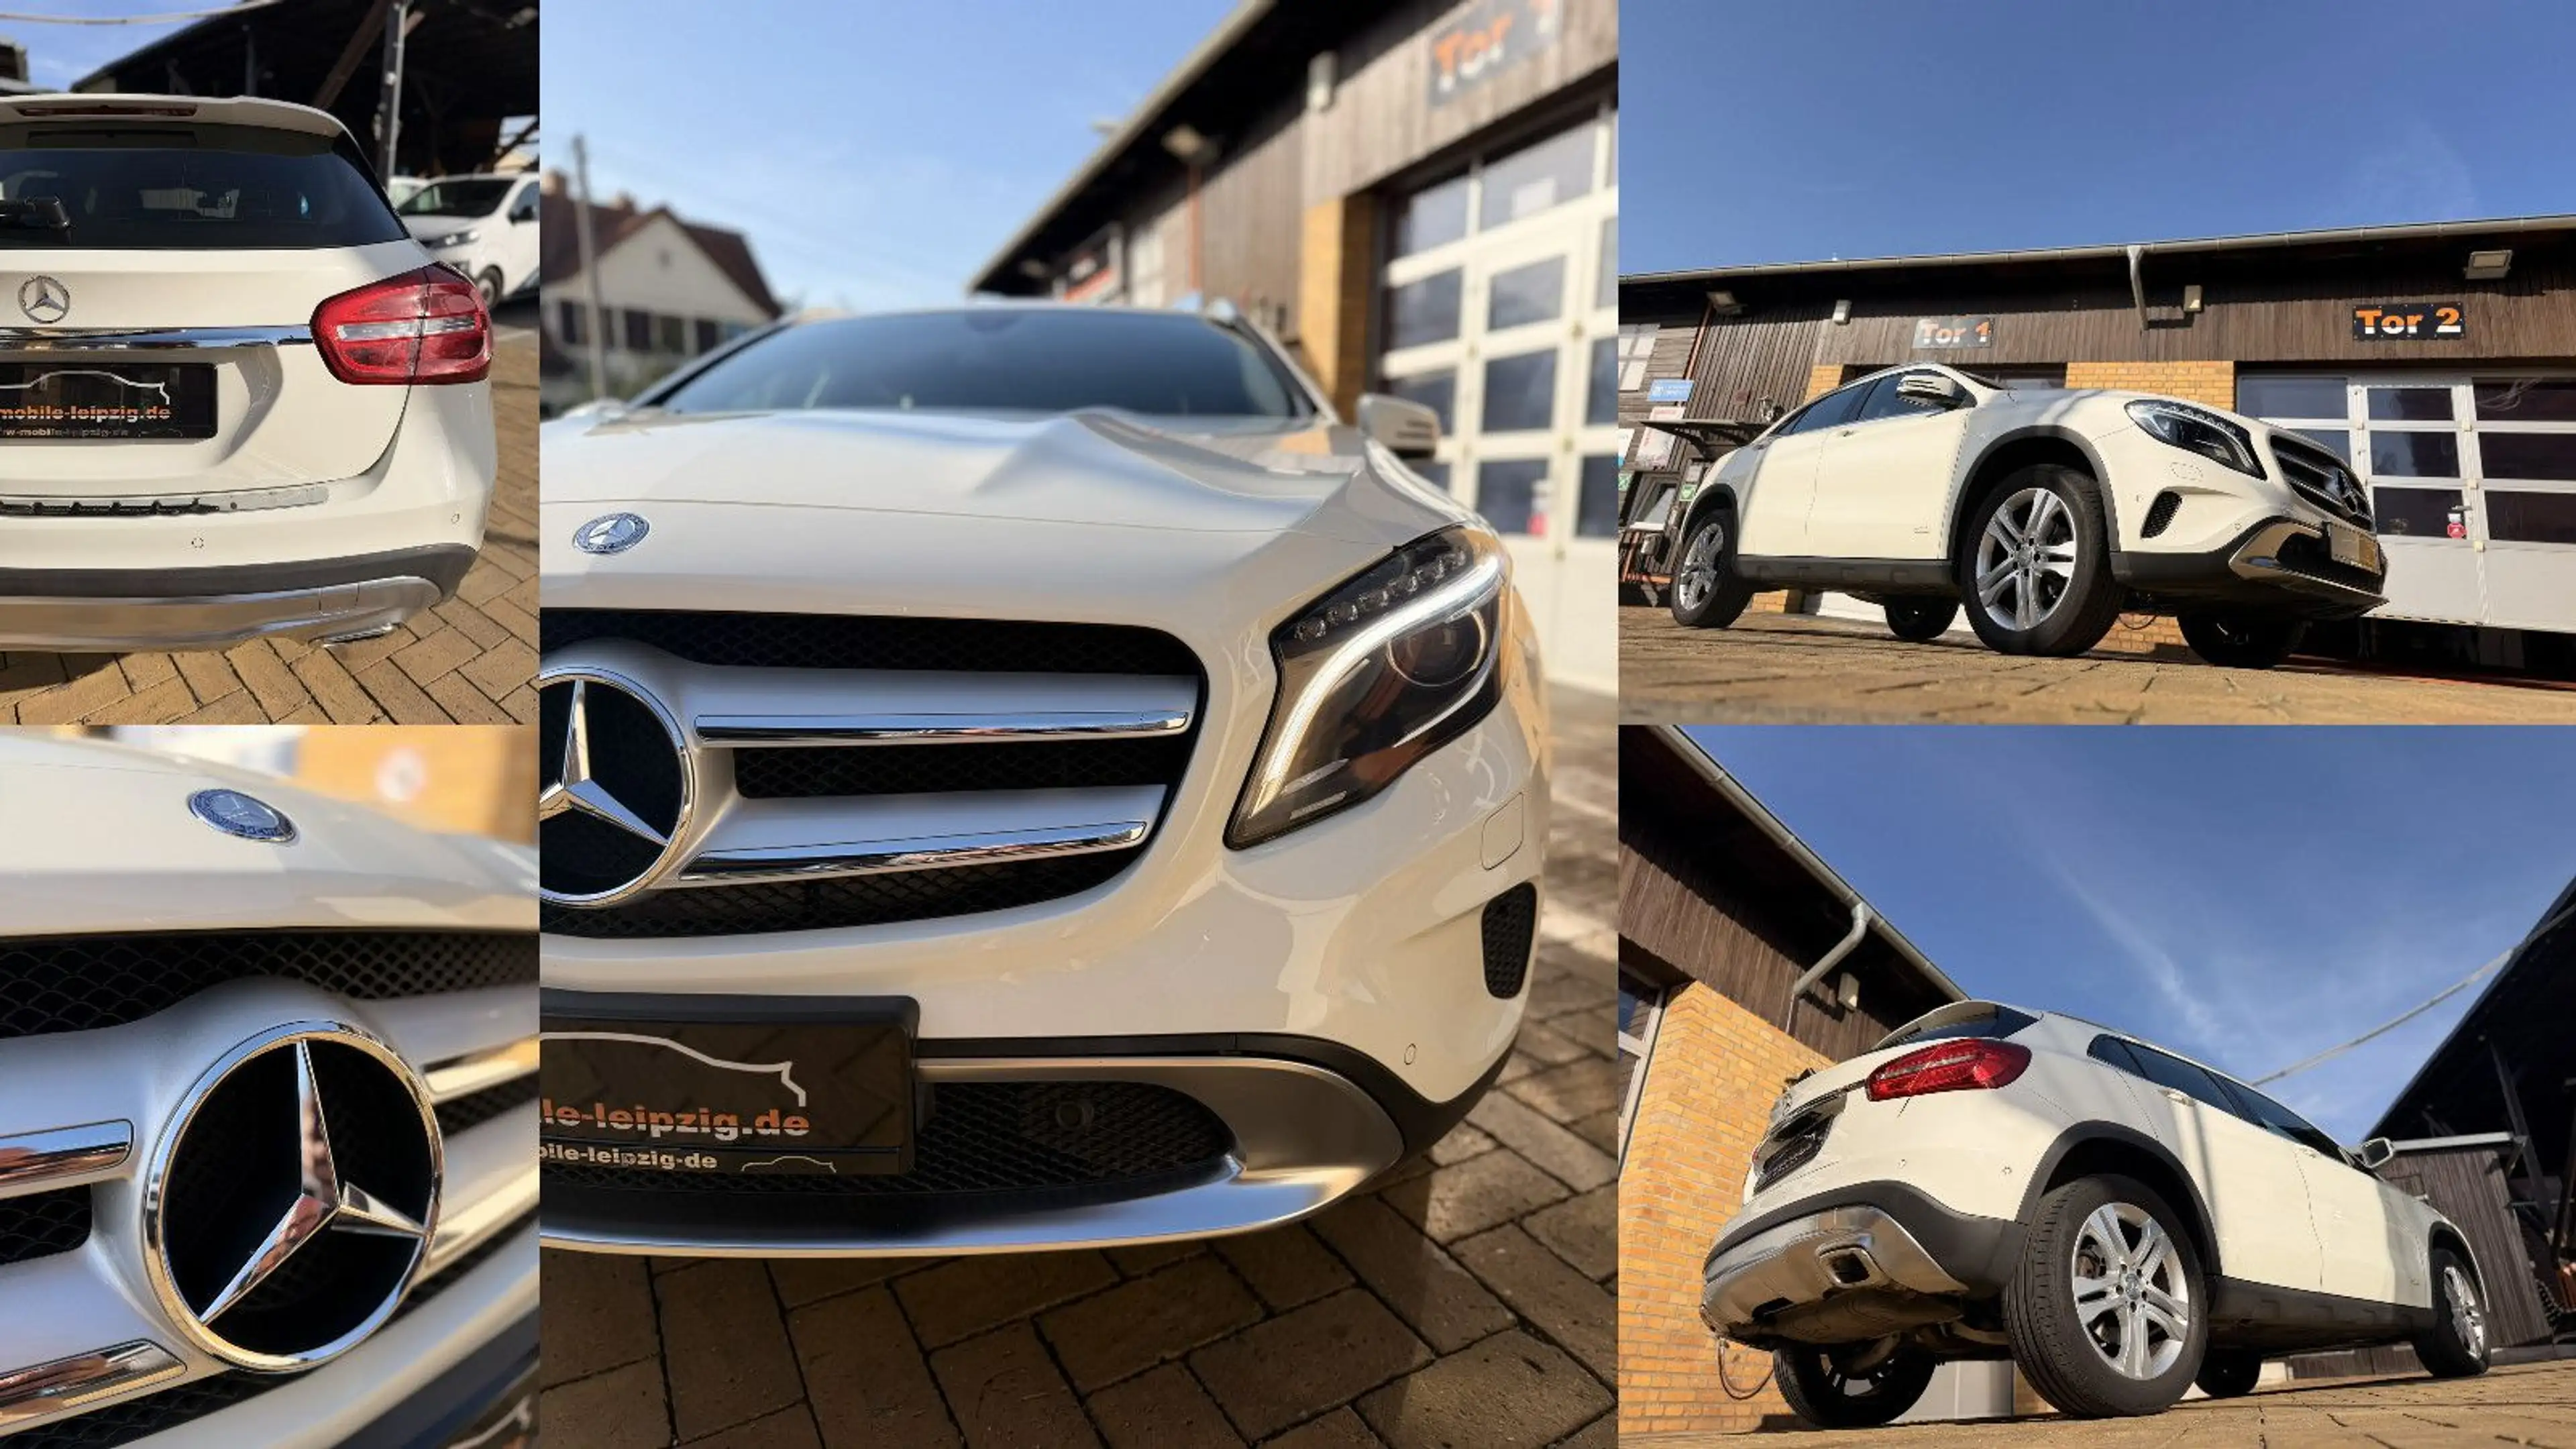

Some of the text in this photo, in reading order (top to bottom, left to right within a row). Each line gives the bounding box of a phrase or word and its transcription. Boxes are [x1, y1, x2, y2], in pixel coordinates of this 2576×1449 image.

[1435, 12, 1513, 93] Tor
[1921, 321, 1990, 344] Tor 1
[2355, 307, 2462, 335] Tor 2
[539, 1098, 810, 1142] le-leipzig.de
